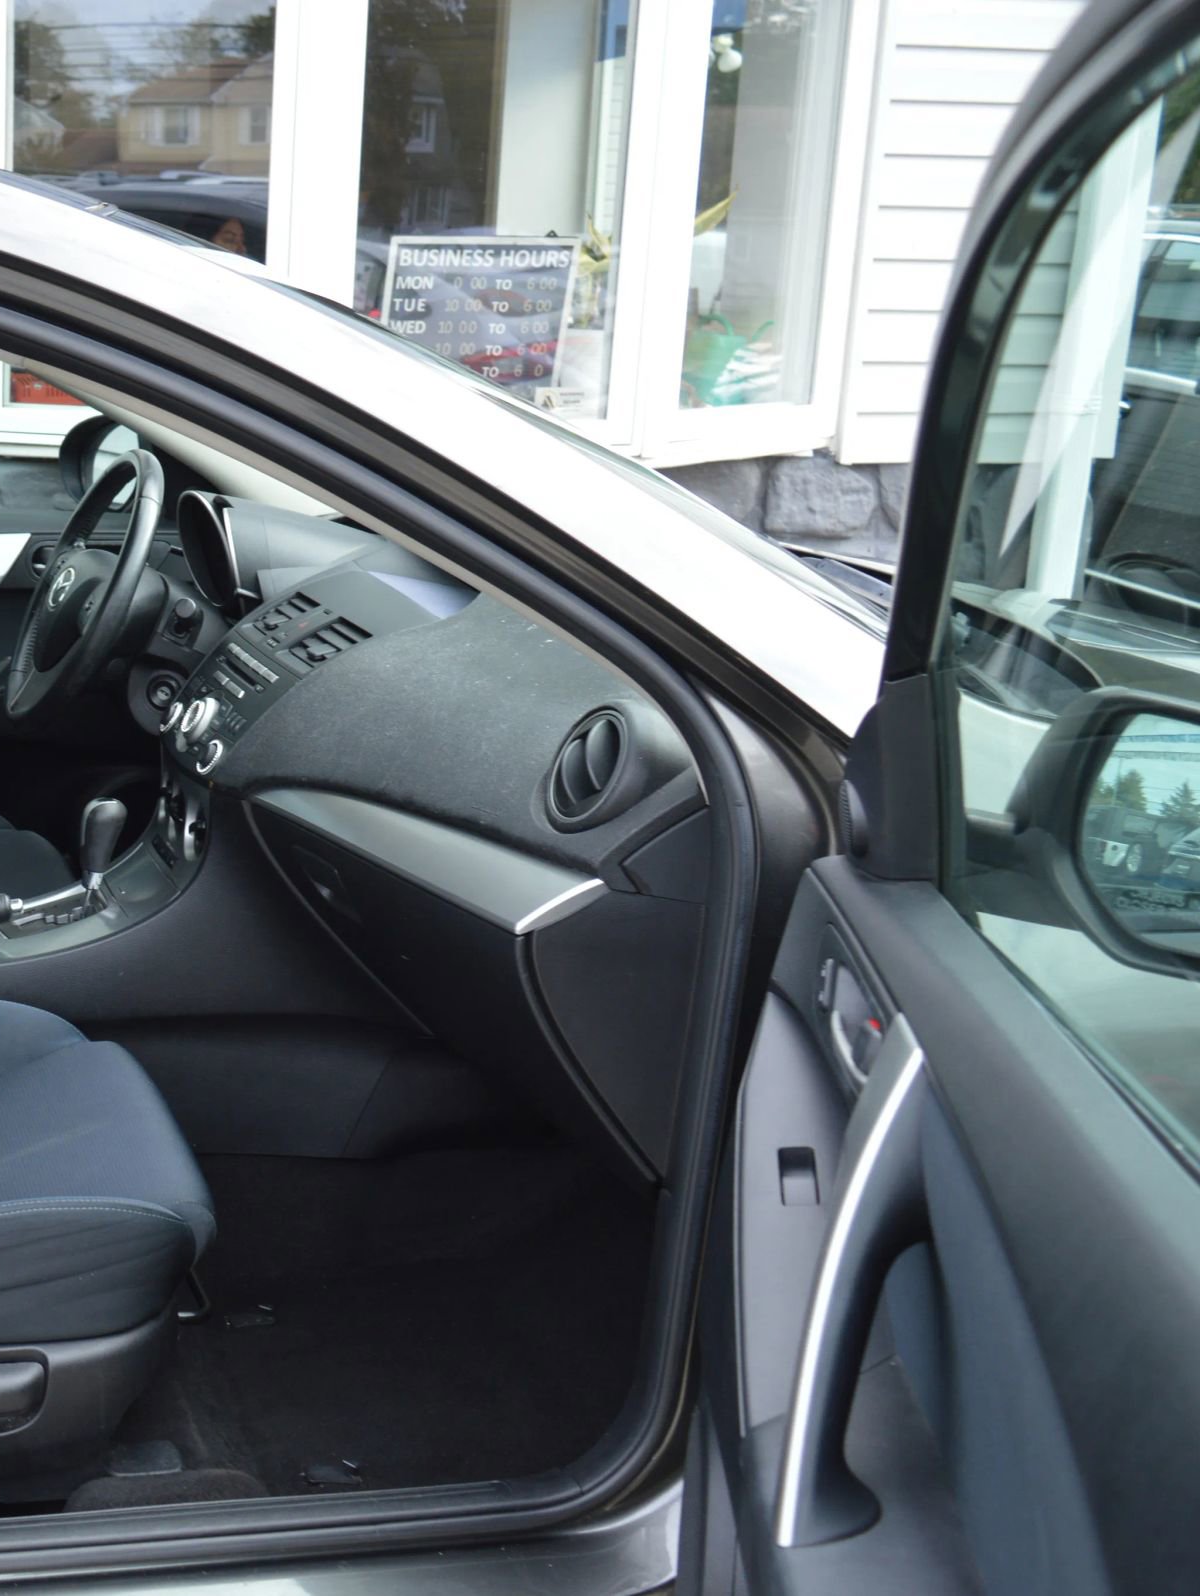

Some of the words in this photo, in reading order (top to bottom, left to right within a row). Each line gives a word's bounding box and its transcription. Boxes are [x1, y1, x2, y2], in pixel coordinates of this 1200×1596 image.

[399, 249, 494, 267] BUSINESS
[499, 250, 570, 268] HOURS
[396, 276, 434, 290] MON
[495, 279, 512, 290] TO
[393, 298, 427, 312] TUE
[491, 301, 509, 312] TO
[390, 320, 426, 334] WED
[488, 322, 506, 334] TO
[485, 344, 503, 356] TO
[481, 366, 499, 377] TO
